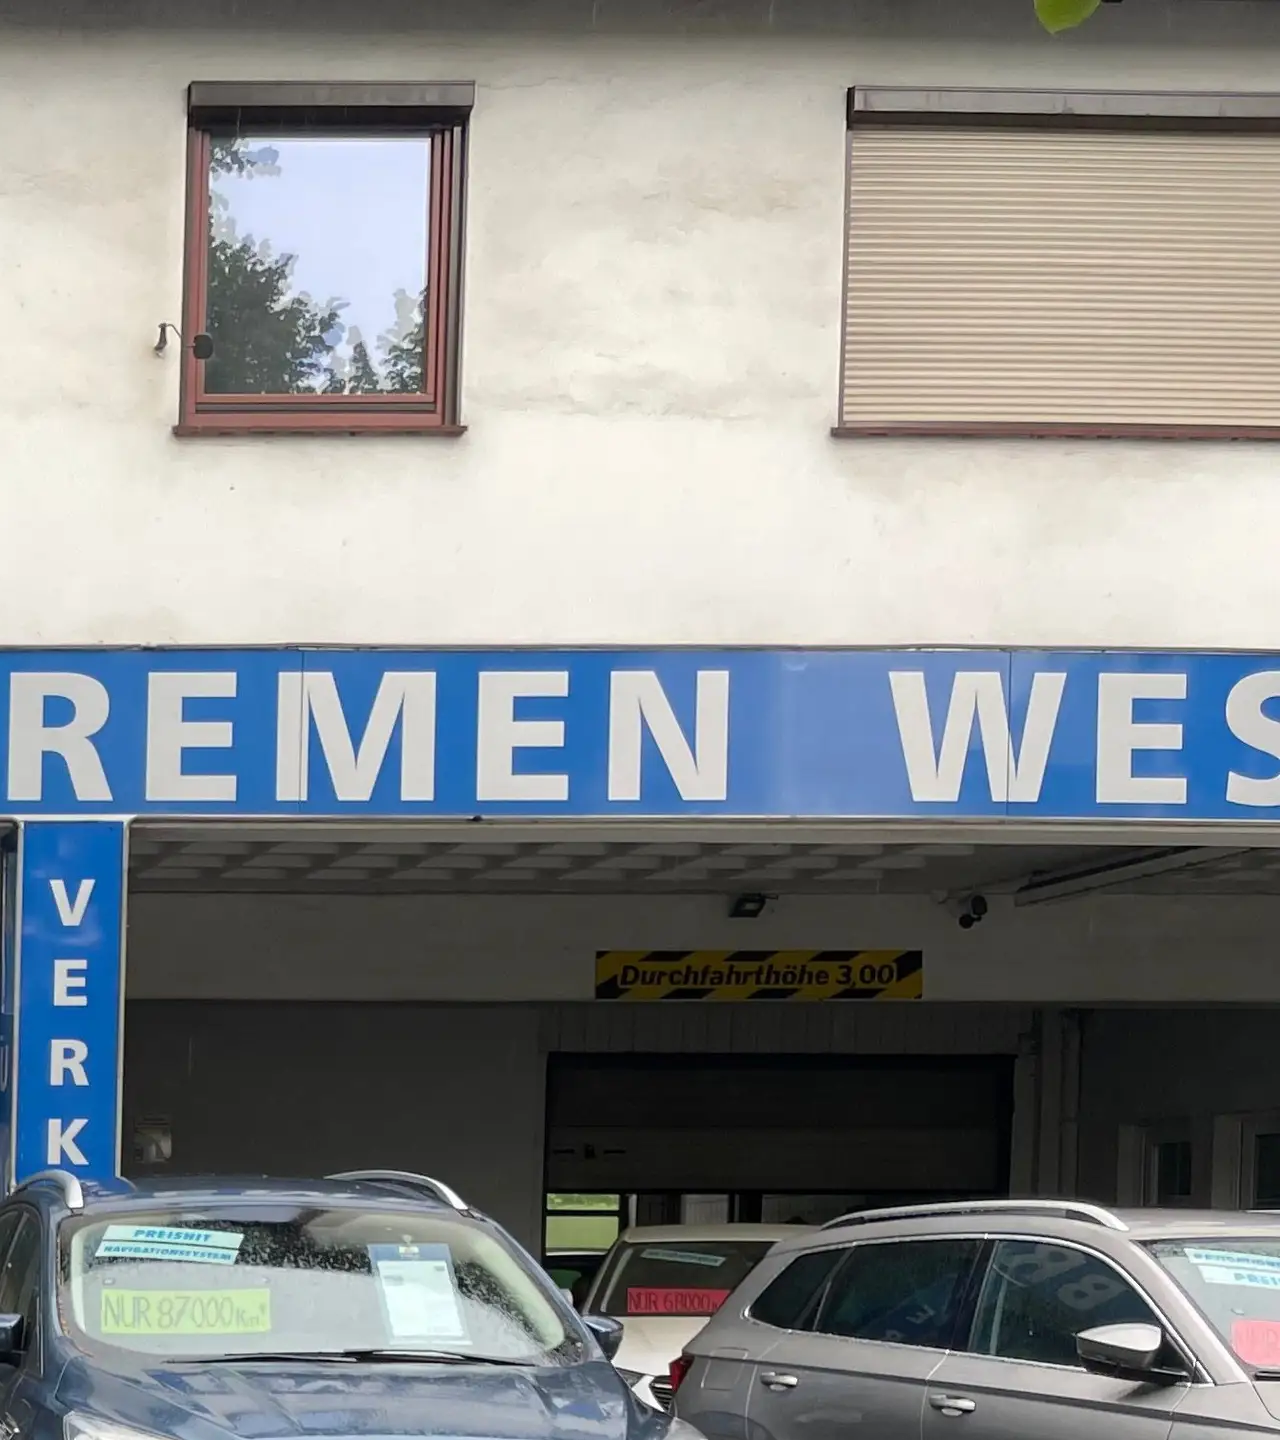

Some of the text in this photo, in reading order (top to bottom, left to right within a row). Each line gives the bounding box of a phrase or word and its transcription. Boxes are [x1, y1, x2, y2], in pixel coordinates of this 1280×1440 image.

[887, 668, 1280, 806] WES
[619, 963, 896, 989] Durchfahrthöhe 3,00
[133, 1229, 213, 1242] PREISHIT
[103, 1294, 152, 1330] NUR
